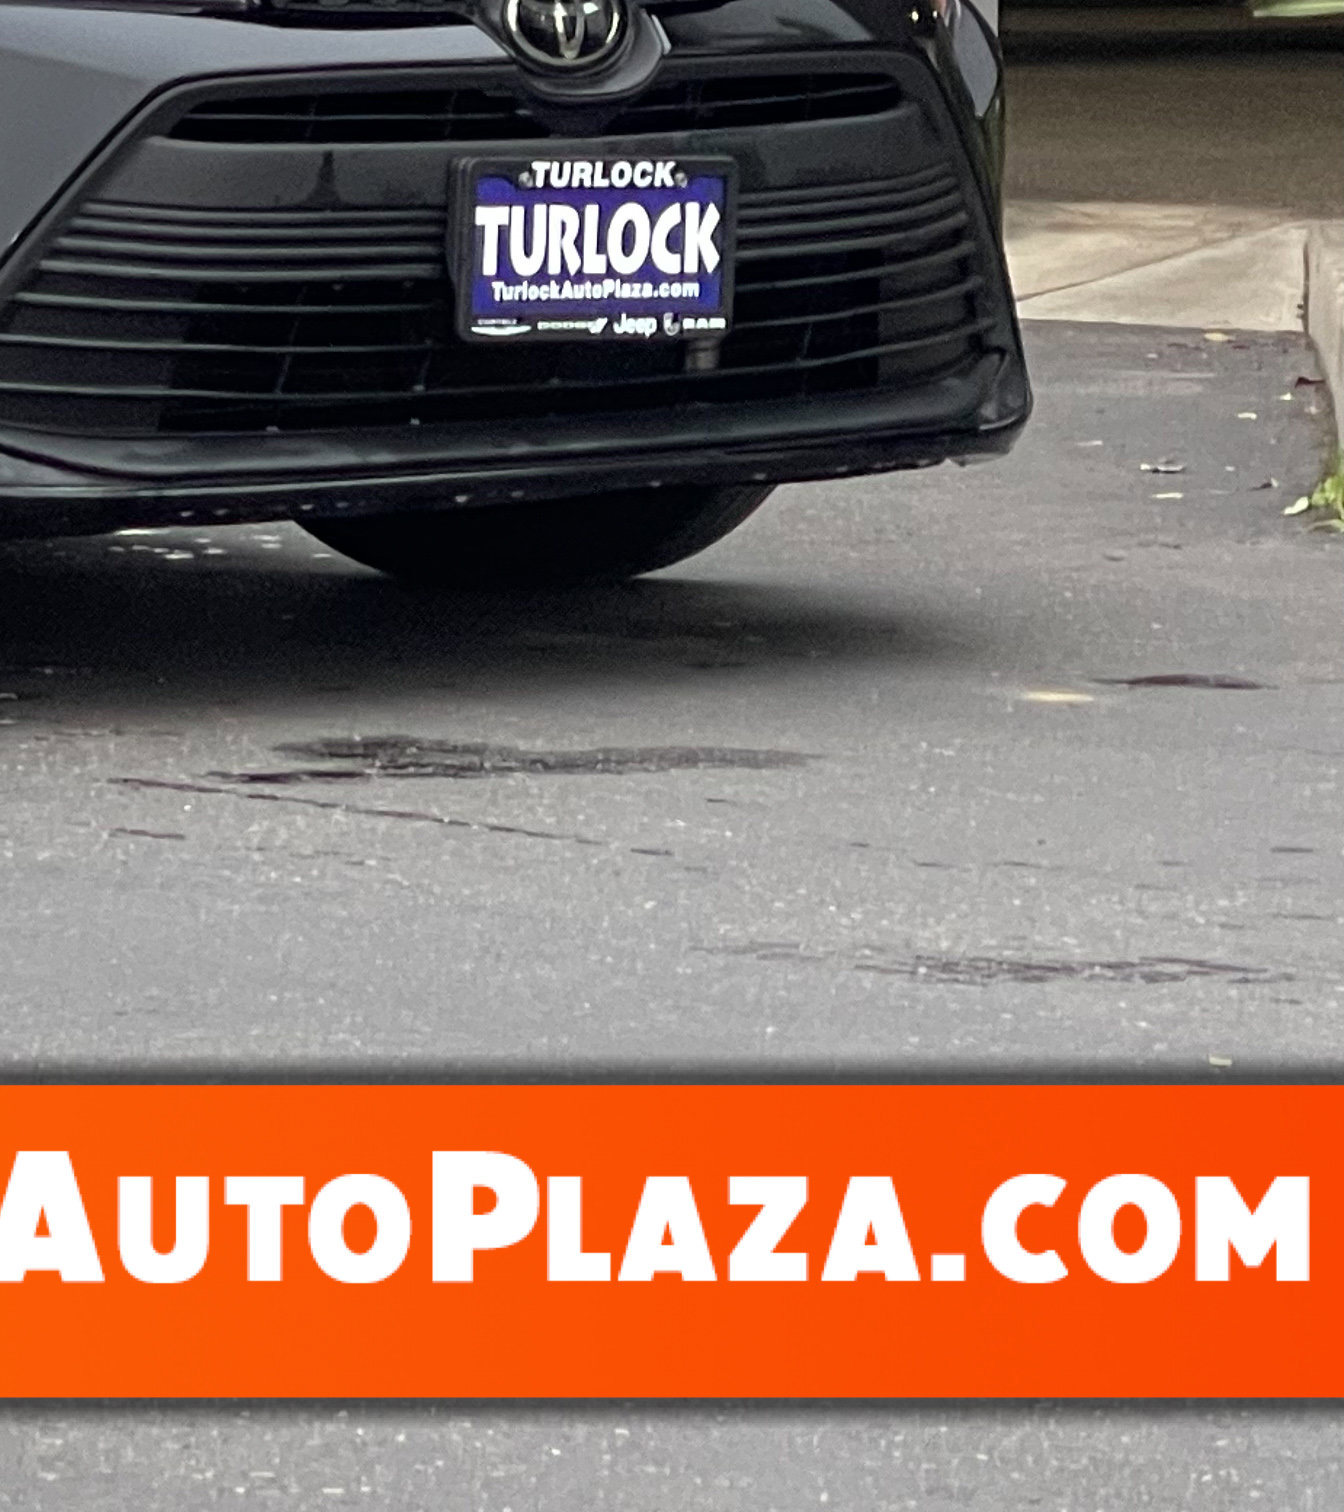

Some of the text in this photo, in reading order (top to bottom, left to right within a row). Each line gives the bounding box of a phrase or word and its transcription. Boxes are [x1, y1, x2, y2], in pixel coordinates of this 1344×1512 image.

[531, 160, 677, 189] TURLOCK
[474, 201, 721, 277] TURLOCK
[491, 278, 700, 302] TurlockAutoPlaza.com
[612, 312, 658, 339] Jeep
[682, 317, 727, 330] RAM
